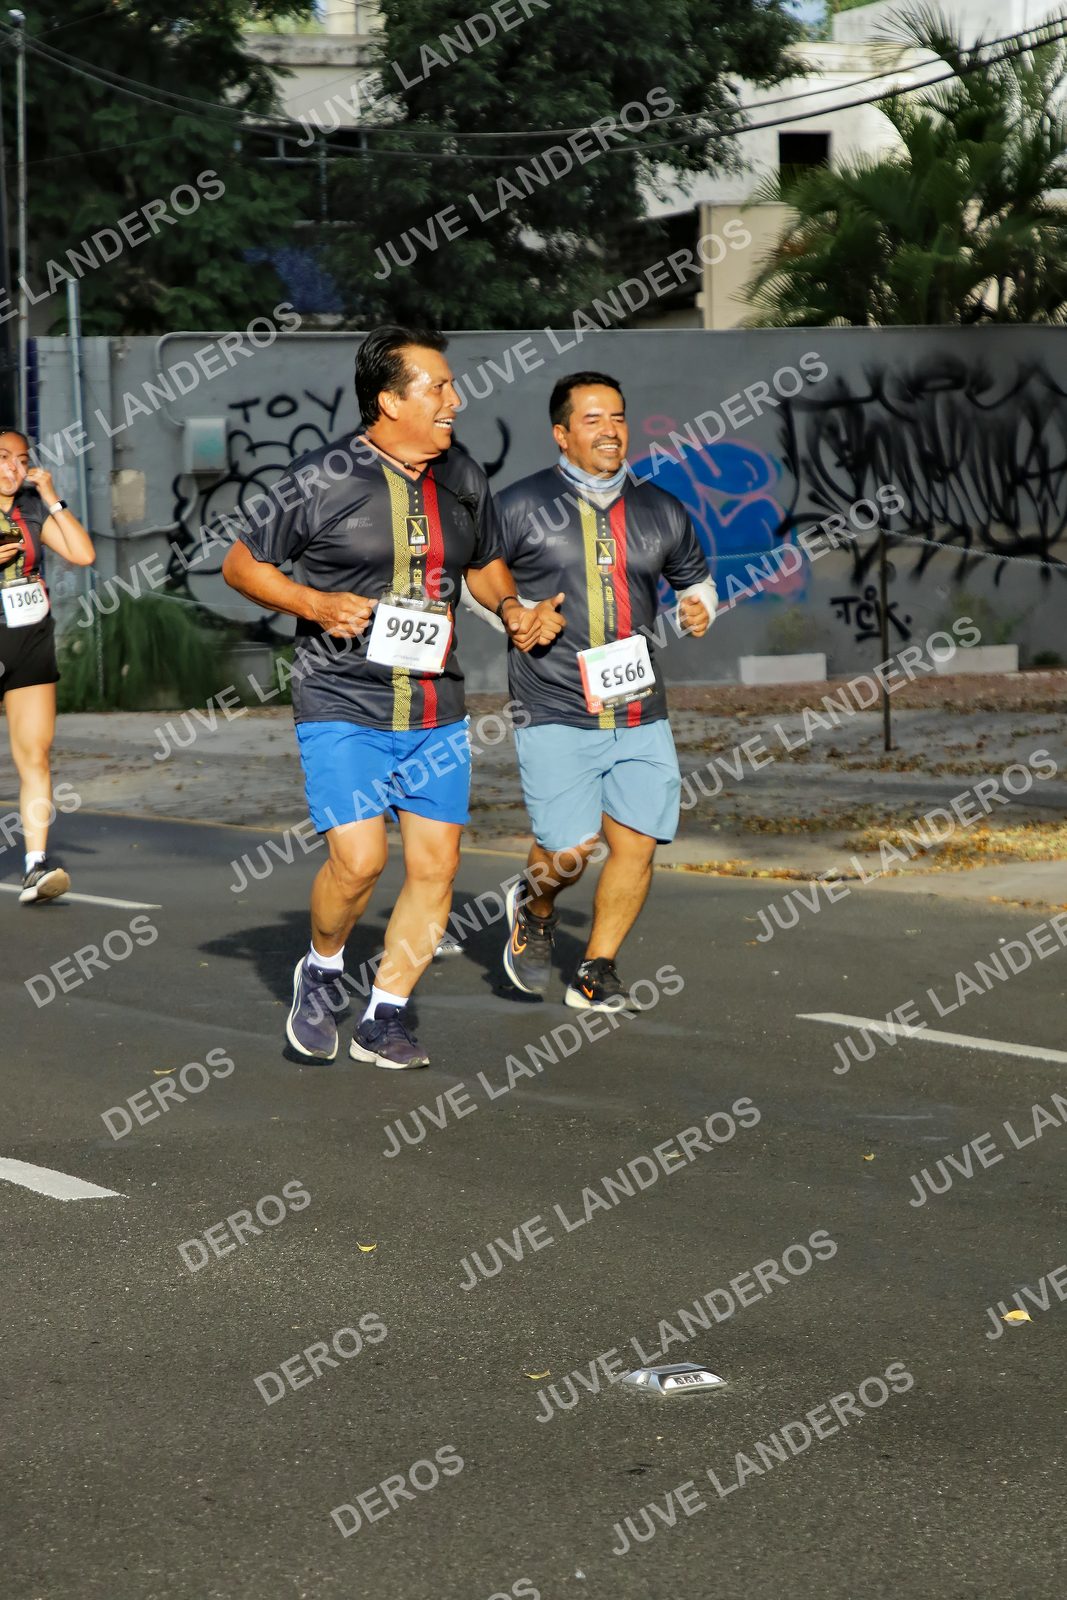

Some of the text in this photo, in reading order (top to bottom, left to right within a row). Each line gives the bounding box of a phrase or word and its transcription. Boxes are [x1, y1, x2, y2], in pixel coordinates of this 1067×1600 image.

[229, 387, 344, 432] TOY
[8, 589, 44, 608] 13063
[386, 617, 440, 645] 9952
[600, 659, 645, 688] 9953
